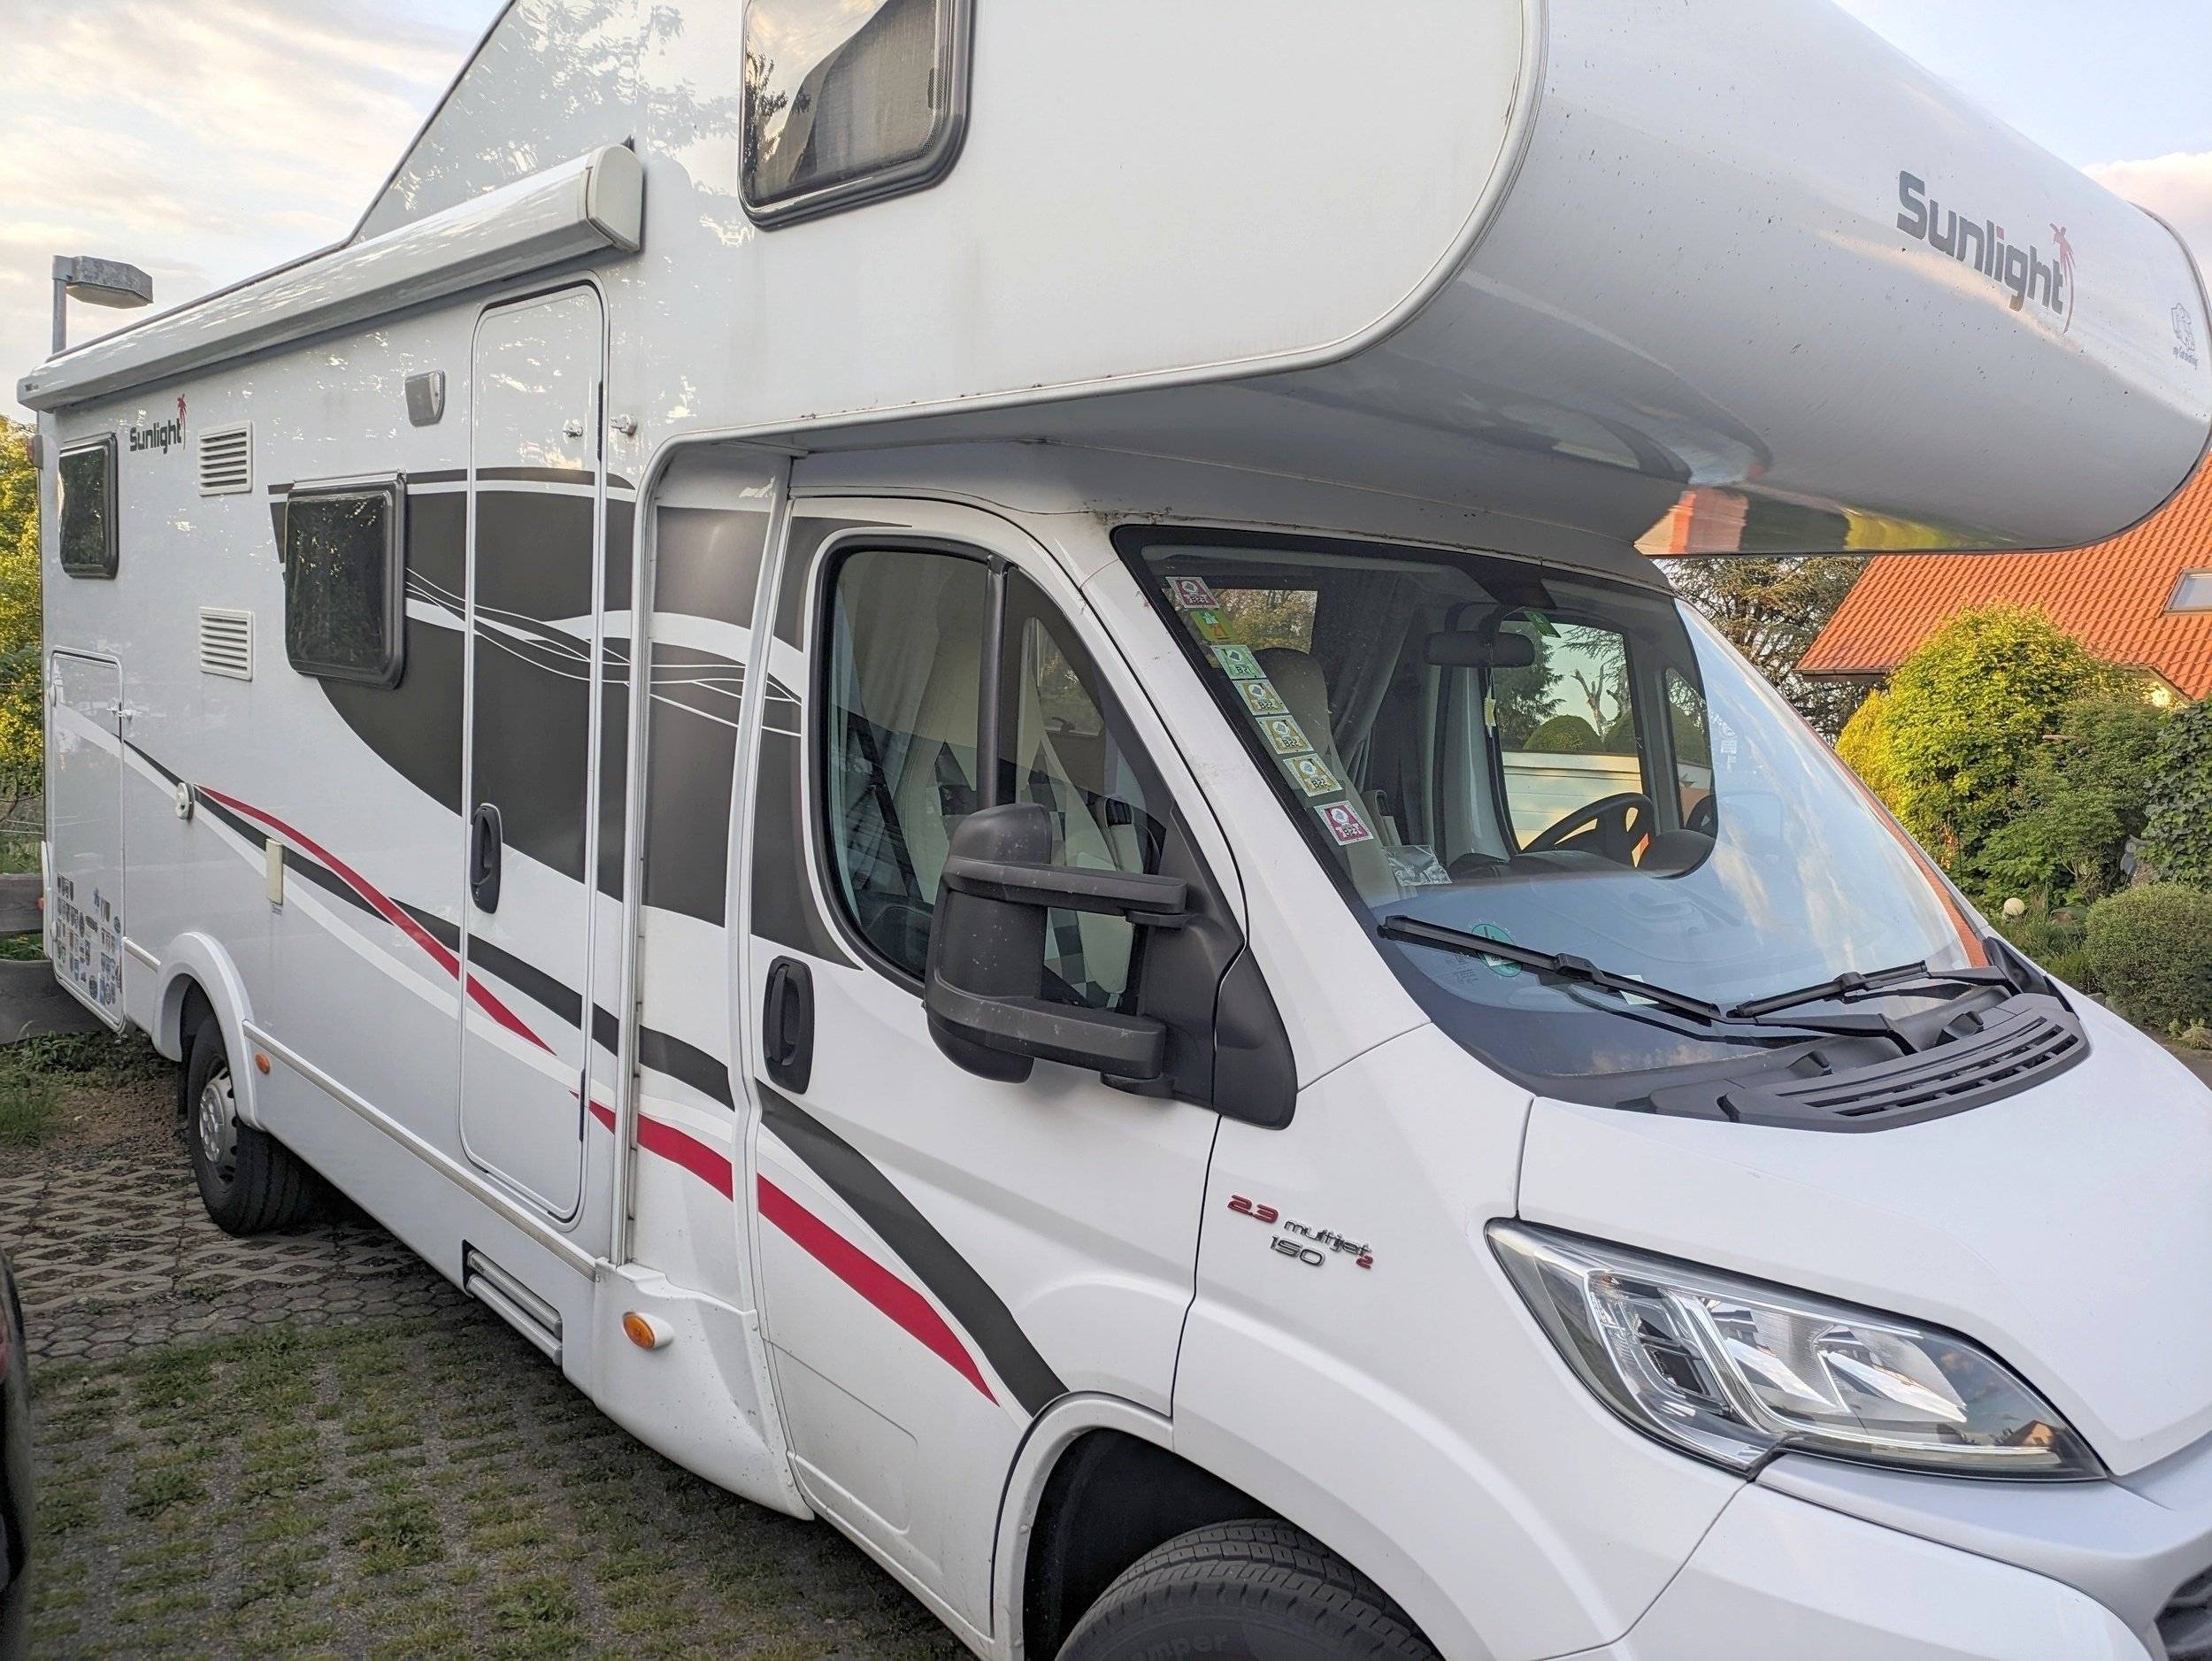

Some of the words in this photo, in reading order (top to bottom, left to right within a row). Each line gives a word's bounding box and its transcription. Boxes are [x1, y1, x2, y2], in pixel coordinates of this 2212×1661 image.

[1896, 169, 2064, 316] Sunlight
[129, 417, 182, 455] Sunlight
[1311, 777, 1329, 789] B22
[1227, 1194, 1279, 1225] 2.3
[1270, 1234, 1326, 1268] 150
